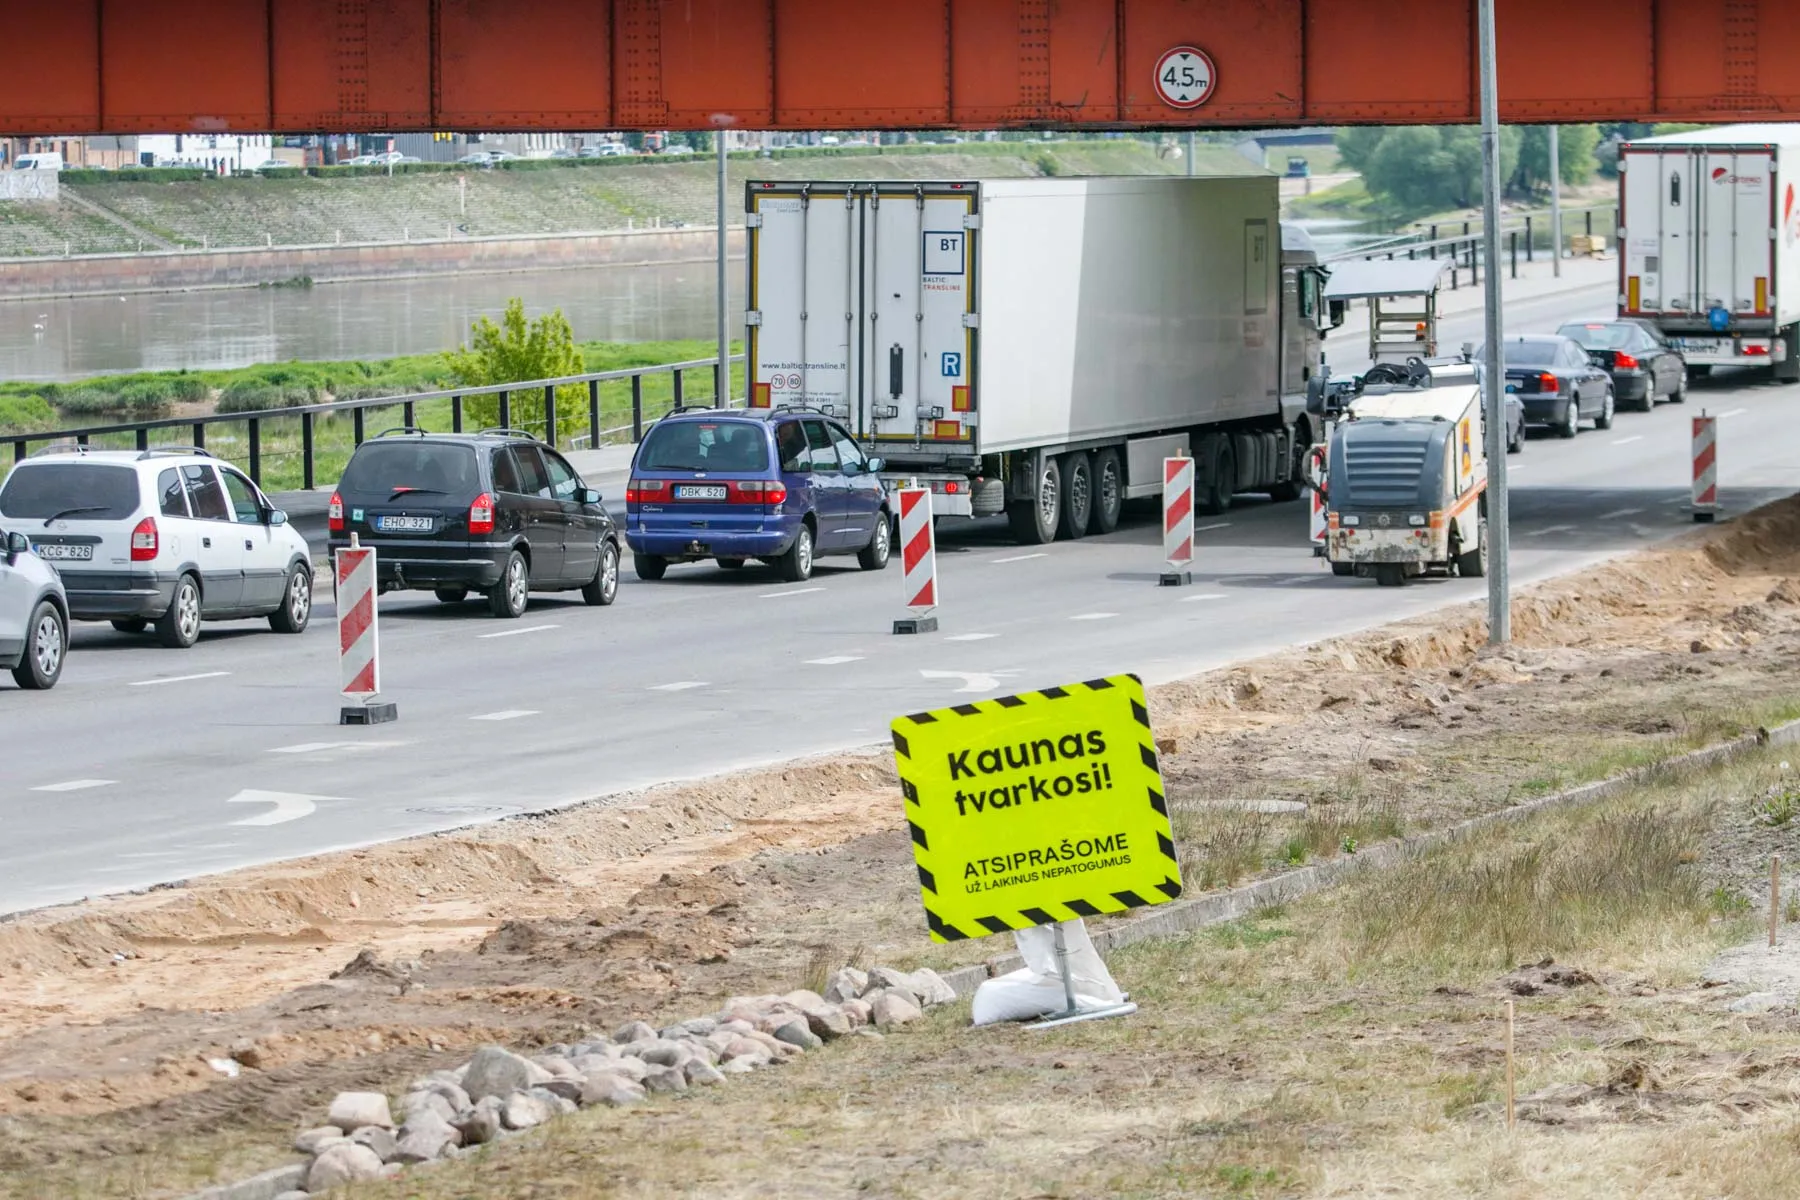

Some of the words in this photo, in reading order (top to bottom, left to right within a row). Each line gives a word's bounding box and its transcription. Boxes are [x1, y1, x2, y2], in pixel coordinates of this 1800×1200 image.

[940, 238, 958, 251] BT
[943, 354, 958, 375] R
[774, 377, 783, 385] 70
[789, 377, 799, 385] 80
[681, 487, 701, 497] DBK
[707, 488, 724, 497] 520
[383, 517, 406, 527] EHO
[412, 518, 430, 528] 321
[39, 547, 63, 557] KCG
[70, 547, 90, 557] 826
[947, 729, 1106, 781] Kaunas
[954, 763, 1113, 816] tvarkosi!
[963, 832, 1129, 879] ATSIPRAŠOME
[965, 879, 982, 894] UŽ
[984, 871, 1039, 890] LAIKINUS
[1042, 854, 1132, 879] NEPATOGUMUS
